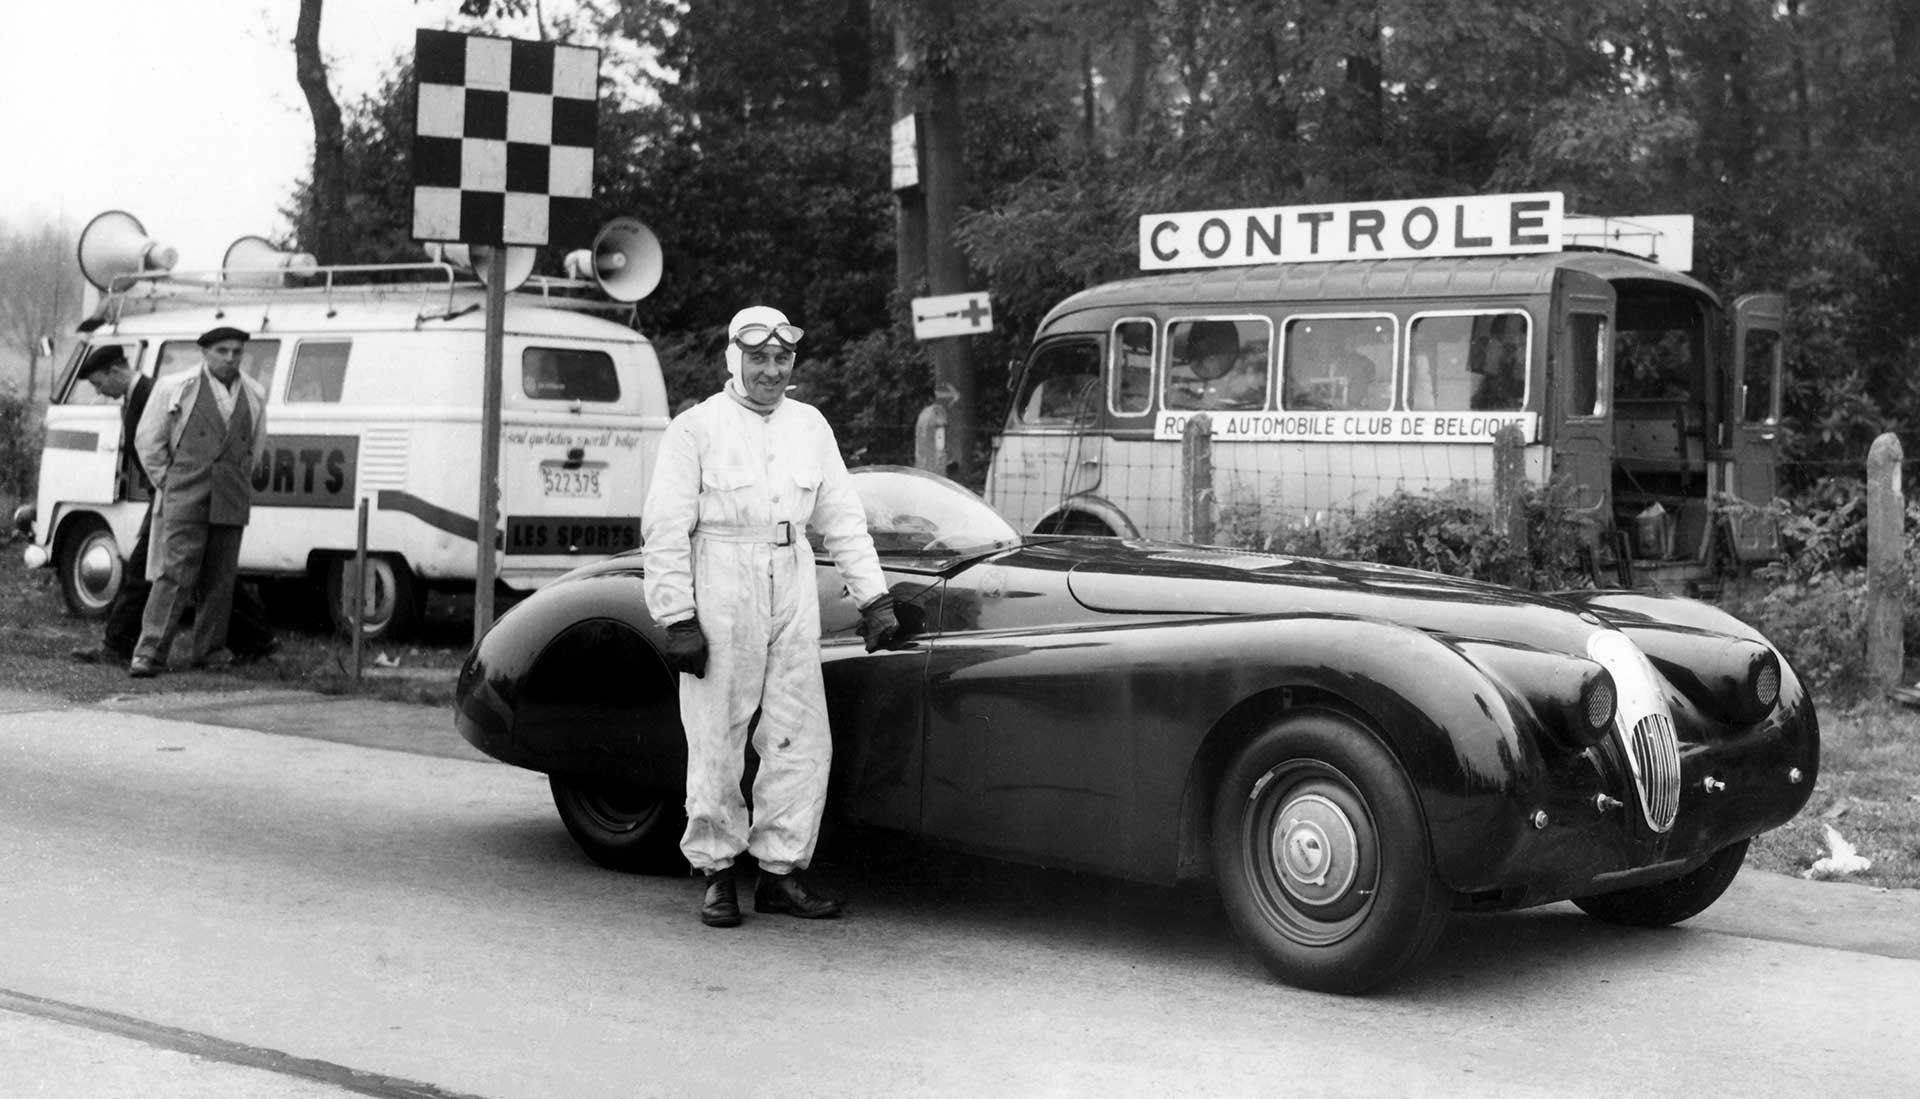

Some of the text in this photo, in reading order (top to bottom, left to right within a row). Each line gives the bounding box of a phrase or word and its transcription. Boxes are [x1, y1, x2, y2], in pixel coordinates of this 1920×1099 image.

[1150, 200, 1550, 262] CONTROLE
[1163, 416, 1218, 435] ROL
[1226, 417, 1336, 436] AUTOMOBILE
[1343, 417, 1393, 436] CLUB
[1401, 417, 1425, 436] DE
[251, 449, 346, 494] ORTS
[513, 525, 635, 547] LES SPORTS
